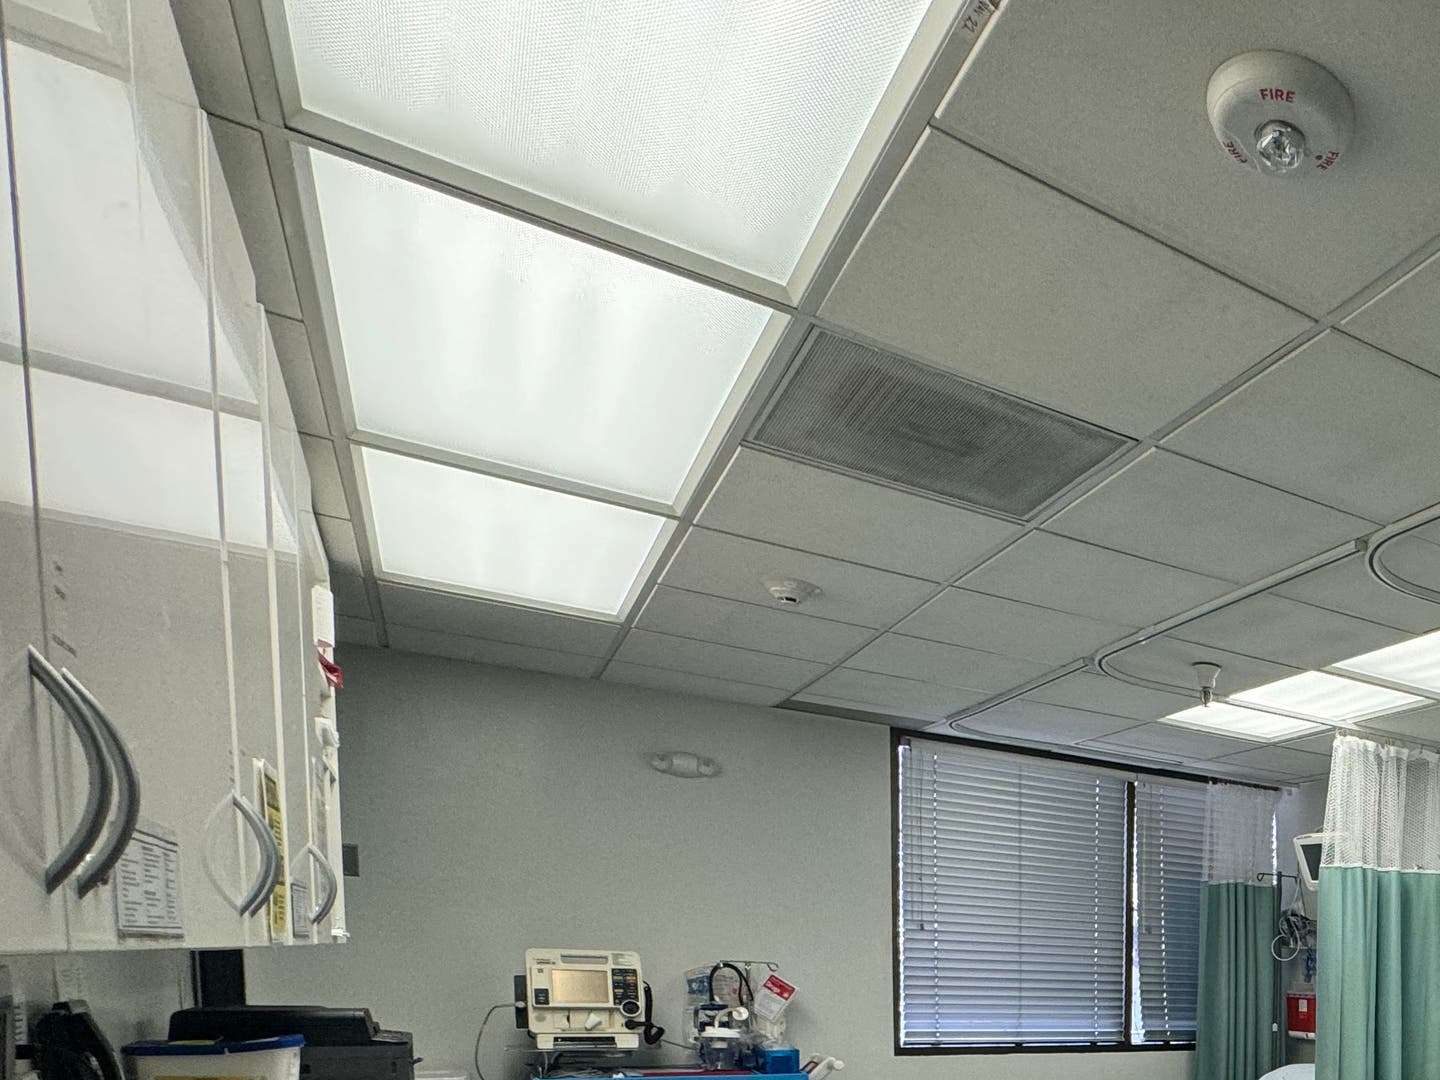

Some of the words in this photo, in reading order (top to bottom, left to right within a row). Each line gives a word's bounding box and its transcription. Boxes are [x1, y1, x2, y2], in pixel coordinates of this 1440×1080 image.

[1259, 88, 1296, 103] FIRE
[1223, 140, 1248, 164] FIRE
[1316, 151, 1340, 171] FIRE
